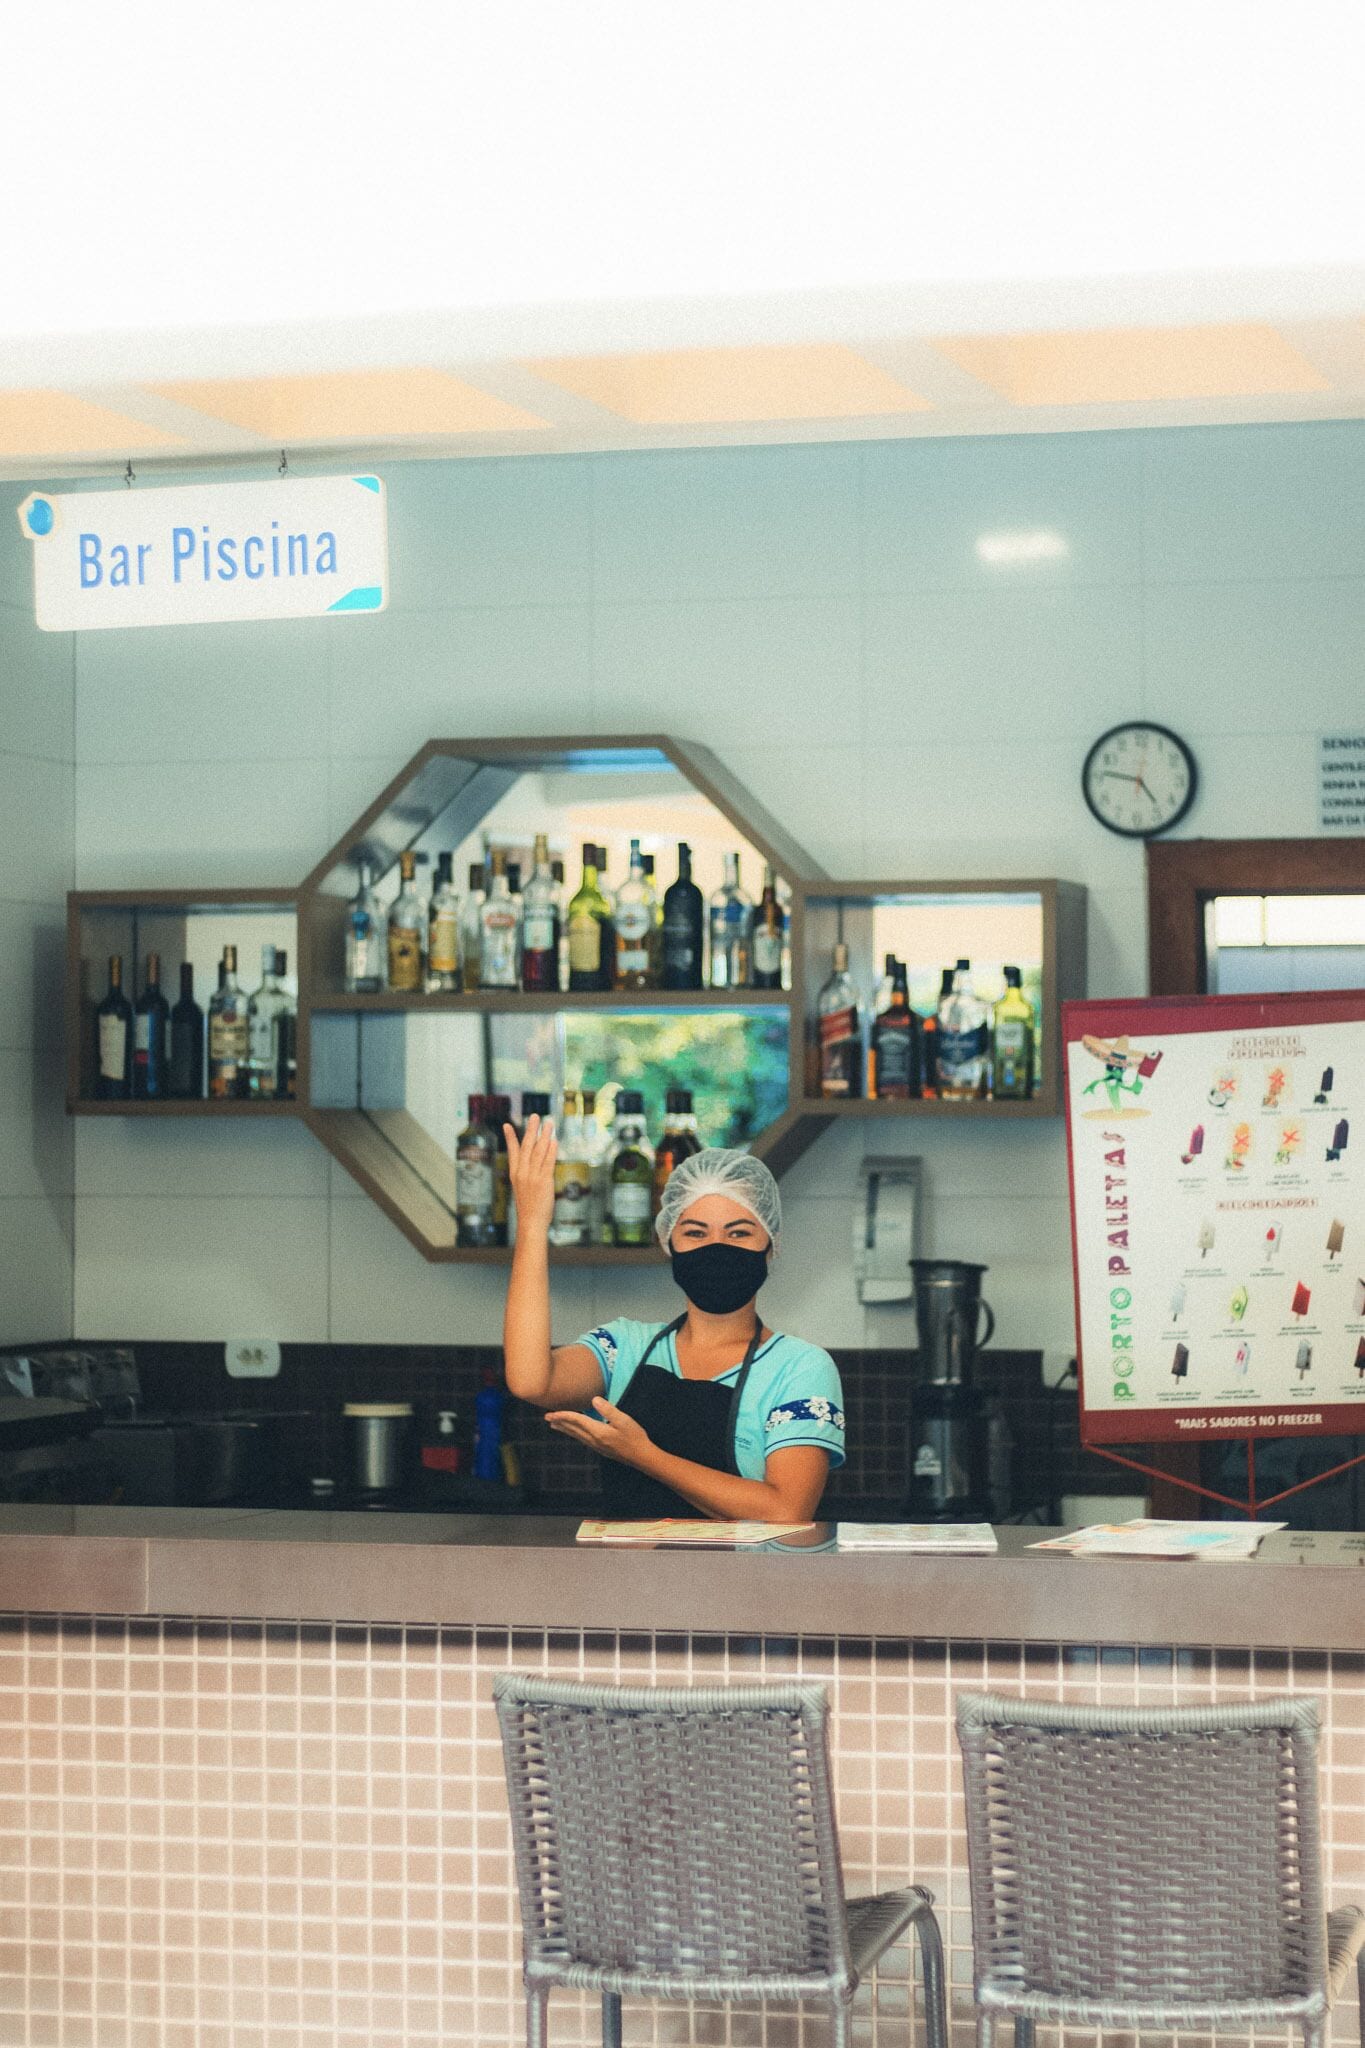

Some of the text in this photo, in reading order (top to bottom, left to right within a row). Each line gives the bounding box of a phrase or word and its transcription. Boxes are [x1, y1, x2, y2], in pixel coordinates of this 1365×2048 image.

[80, 521, 338, 589] Bar Piscina
[1102, 1130, 1136, 1401] PORTO PALETAS
[1209, 1415, 1257, 1428] SABORES
[1259, 1415, 1276, 1427] NO
[1278, 1413, 1323, 1426] FREEZER
